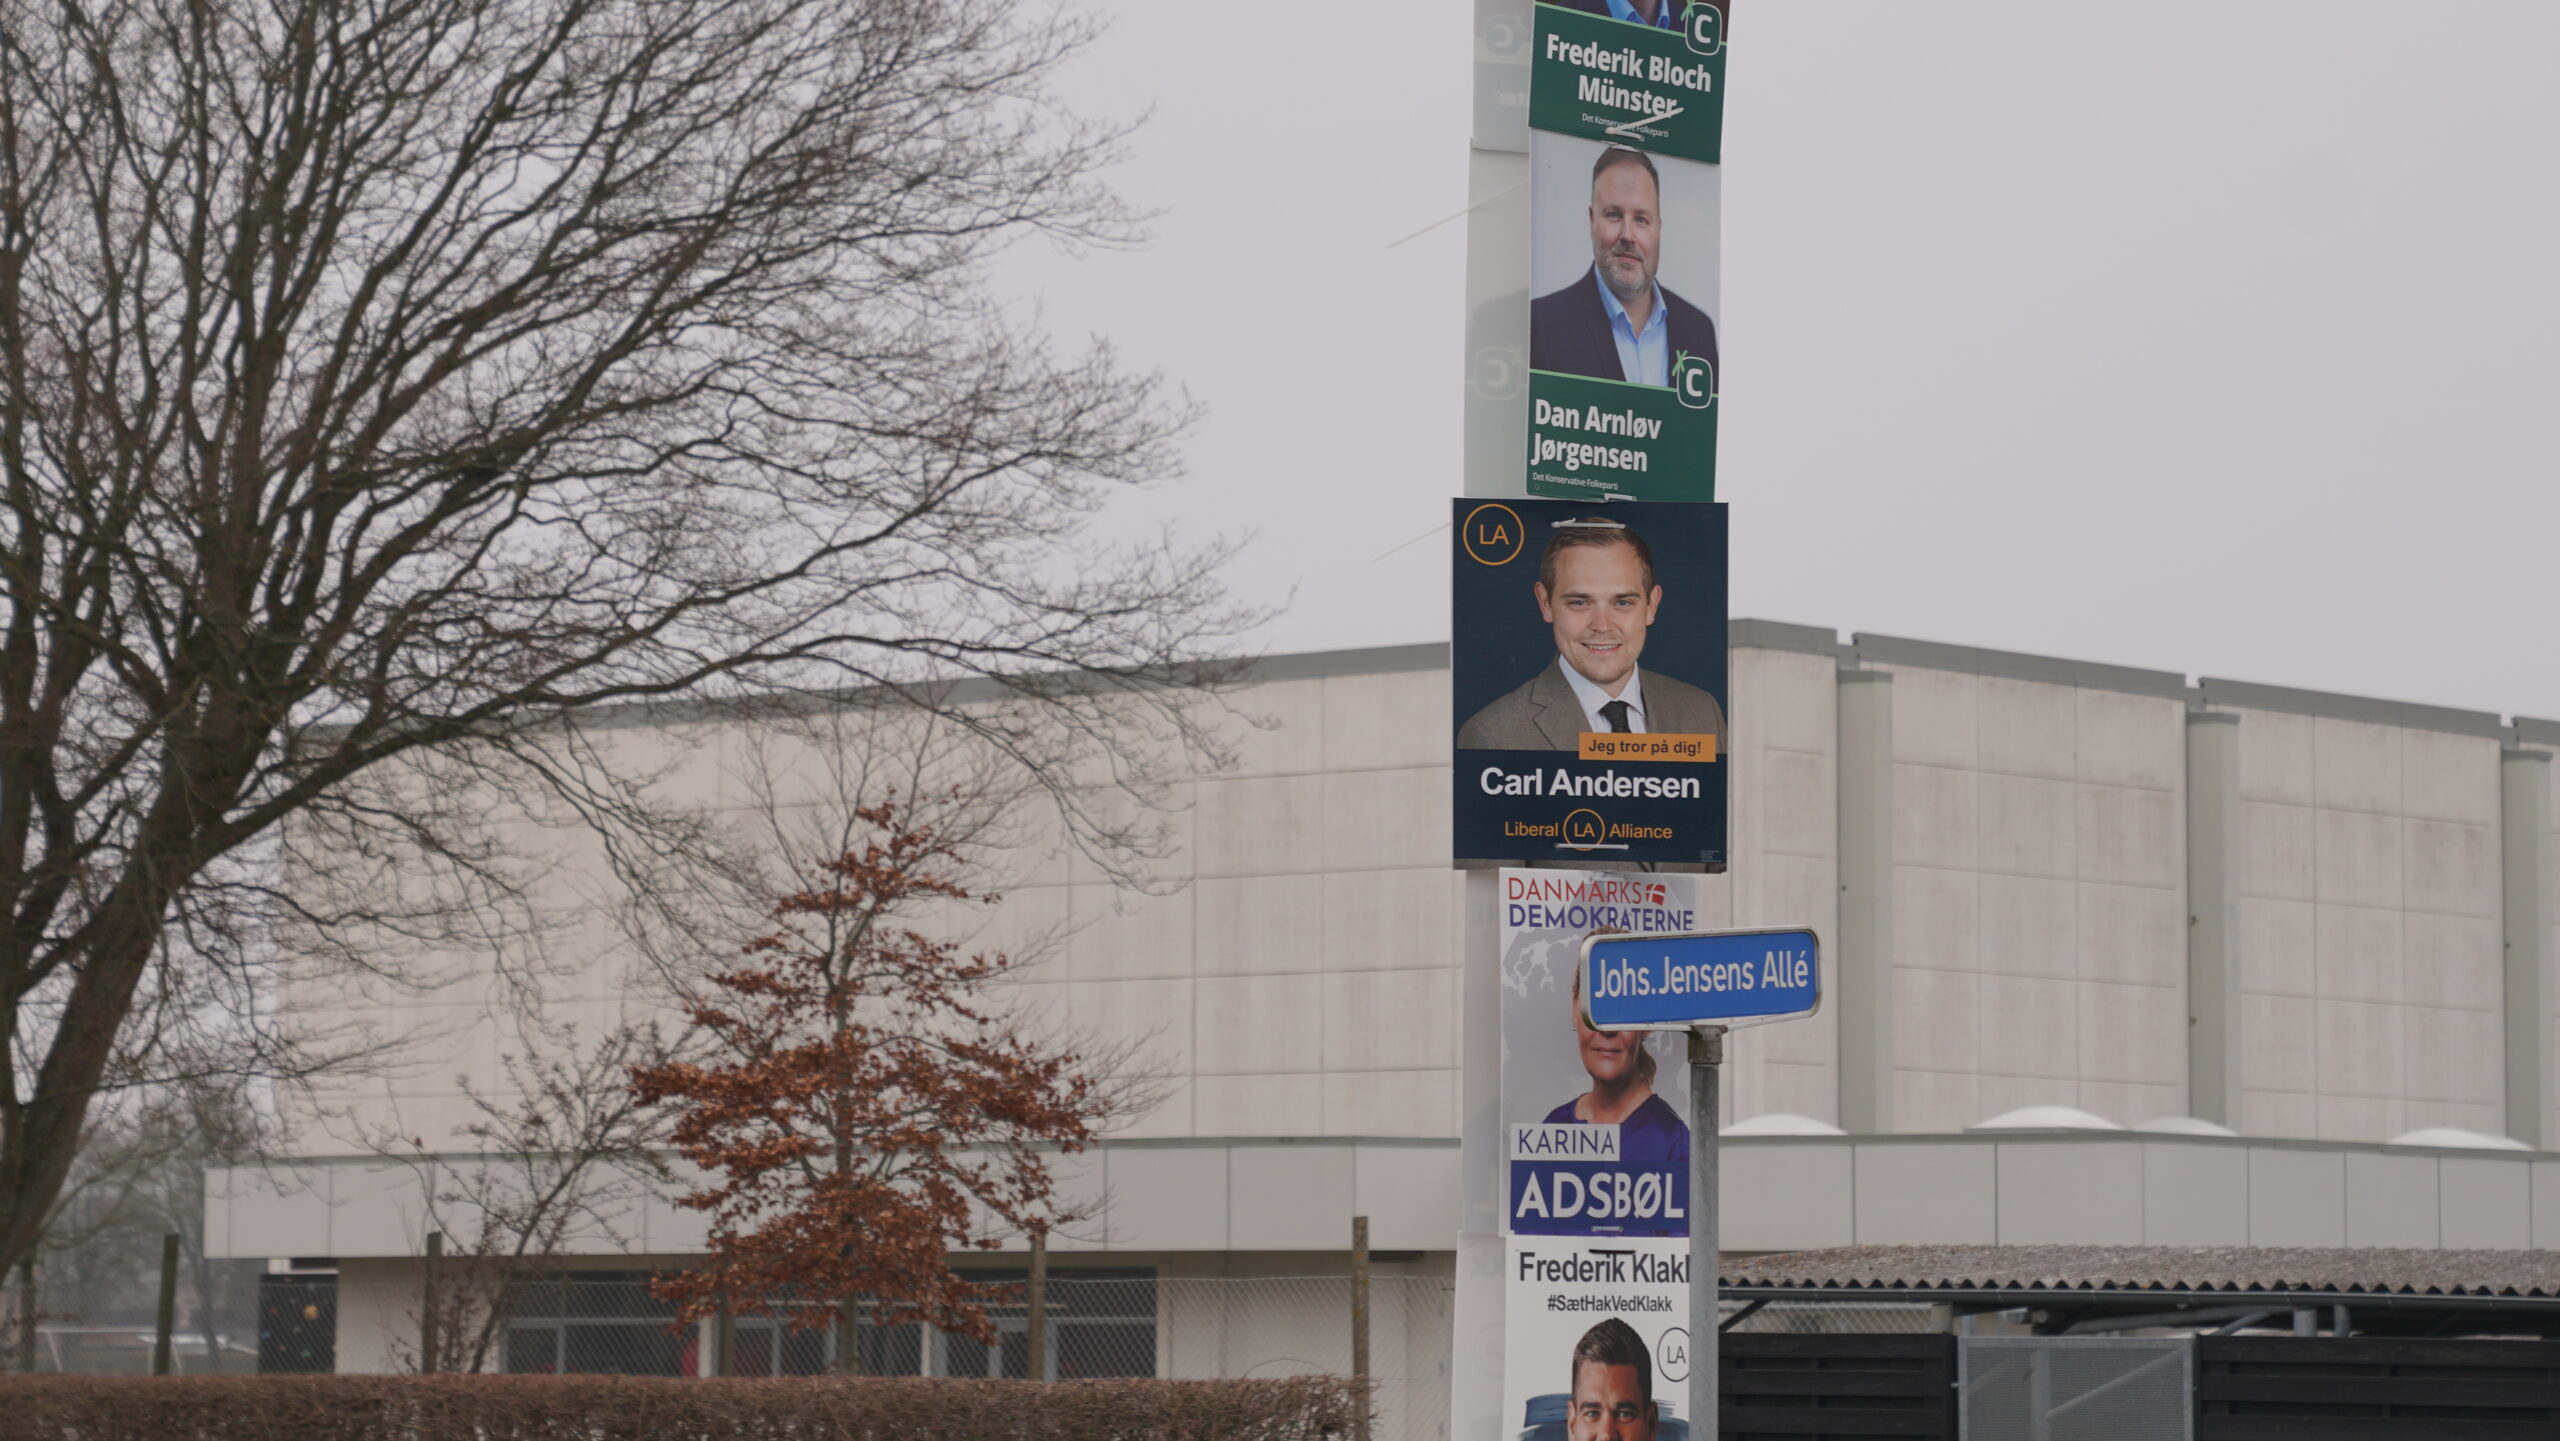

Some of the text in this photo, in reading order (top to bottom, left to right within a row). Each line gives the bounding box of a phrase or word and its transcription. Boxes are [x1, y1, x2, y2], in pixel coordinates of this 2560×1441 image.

[1694, 15, 1712, 43] C
[1547, 34, 1711, 91] Frederik Bloch
[1579, 75, 1677, 117] Münster
[1582, 113, 1594, 123] Det
[1686, 368, 1703, 397] C
[1535, 399, 1662, 439] Dan Arnløv
[1530, 433, 1648, 472] Jørgensen
[1533, 472, 1619, 490] Det Konservative Folkeparti
[1480, 524, 1510, 545] LA
[1589, 740, 1701, 756] Jeg tror på dig!
[1480, 766, 1700, 798] Carl Andersen
[1504, 821, 1673, 839] Liberal LA Alliance
[1508, 877, 1642, 905] DANMARKS
[1509, 904, 1694, 931] DEMOKRATERNE
[1761, 949, 1809, 989] Allé
[1518, 1129, 1615, 1155] KARINA
[1515, 1170, 1684, 1219] ADSBØL
[1519, 1251, 1626, 1283] Frederik
[1547, 1294, 1673, 1313] #SætHakVedKlakk
[1667, 1345, 1686, 1365] LA
